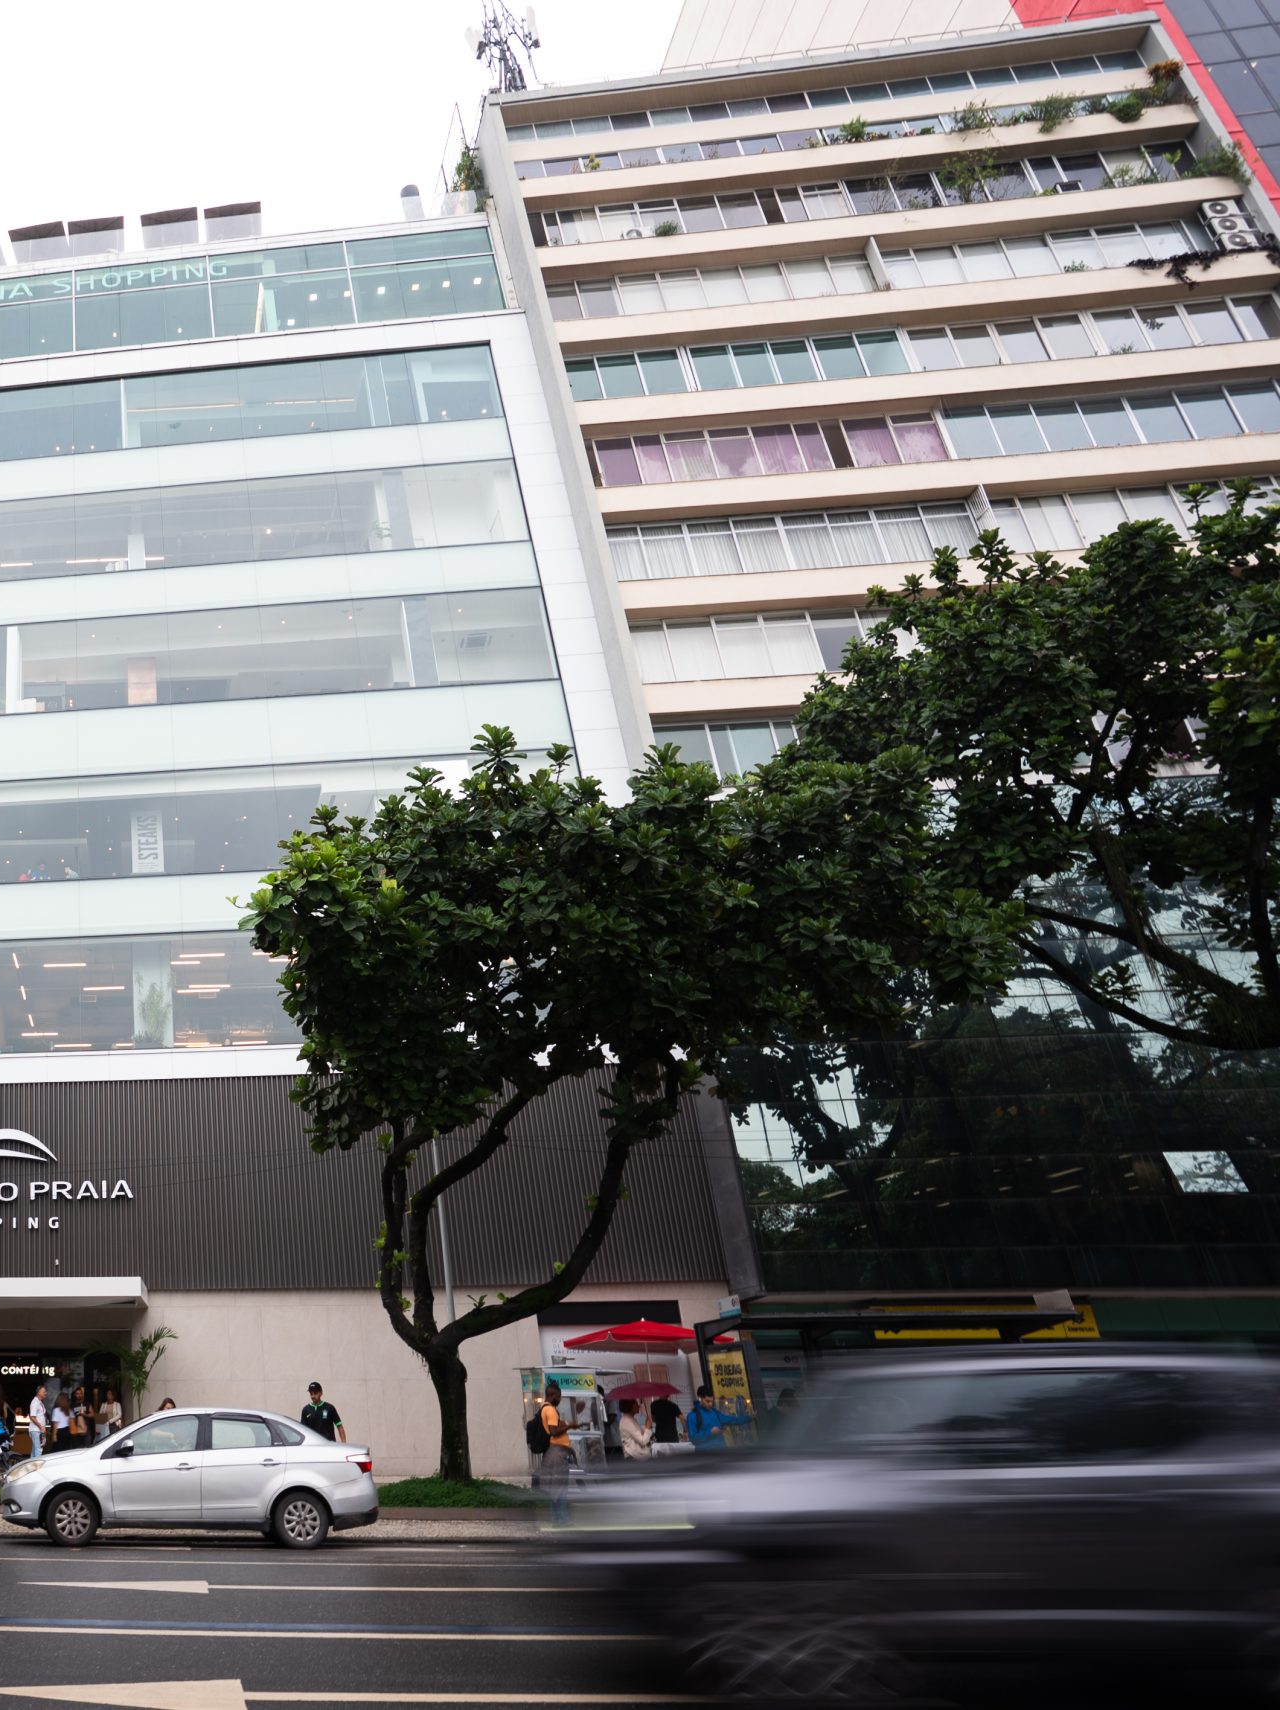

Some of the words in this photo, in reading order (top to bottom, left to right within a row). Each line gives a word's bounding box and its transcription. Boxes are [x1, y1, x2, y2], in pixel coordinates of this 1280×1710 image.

[53, 260, 228, 294] SHOPPING
[136, 815, 158, 861] STEAKS
[30, 1180, 134, 1201] PRAIA
